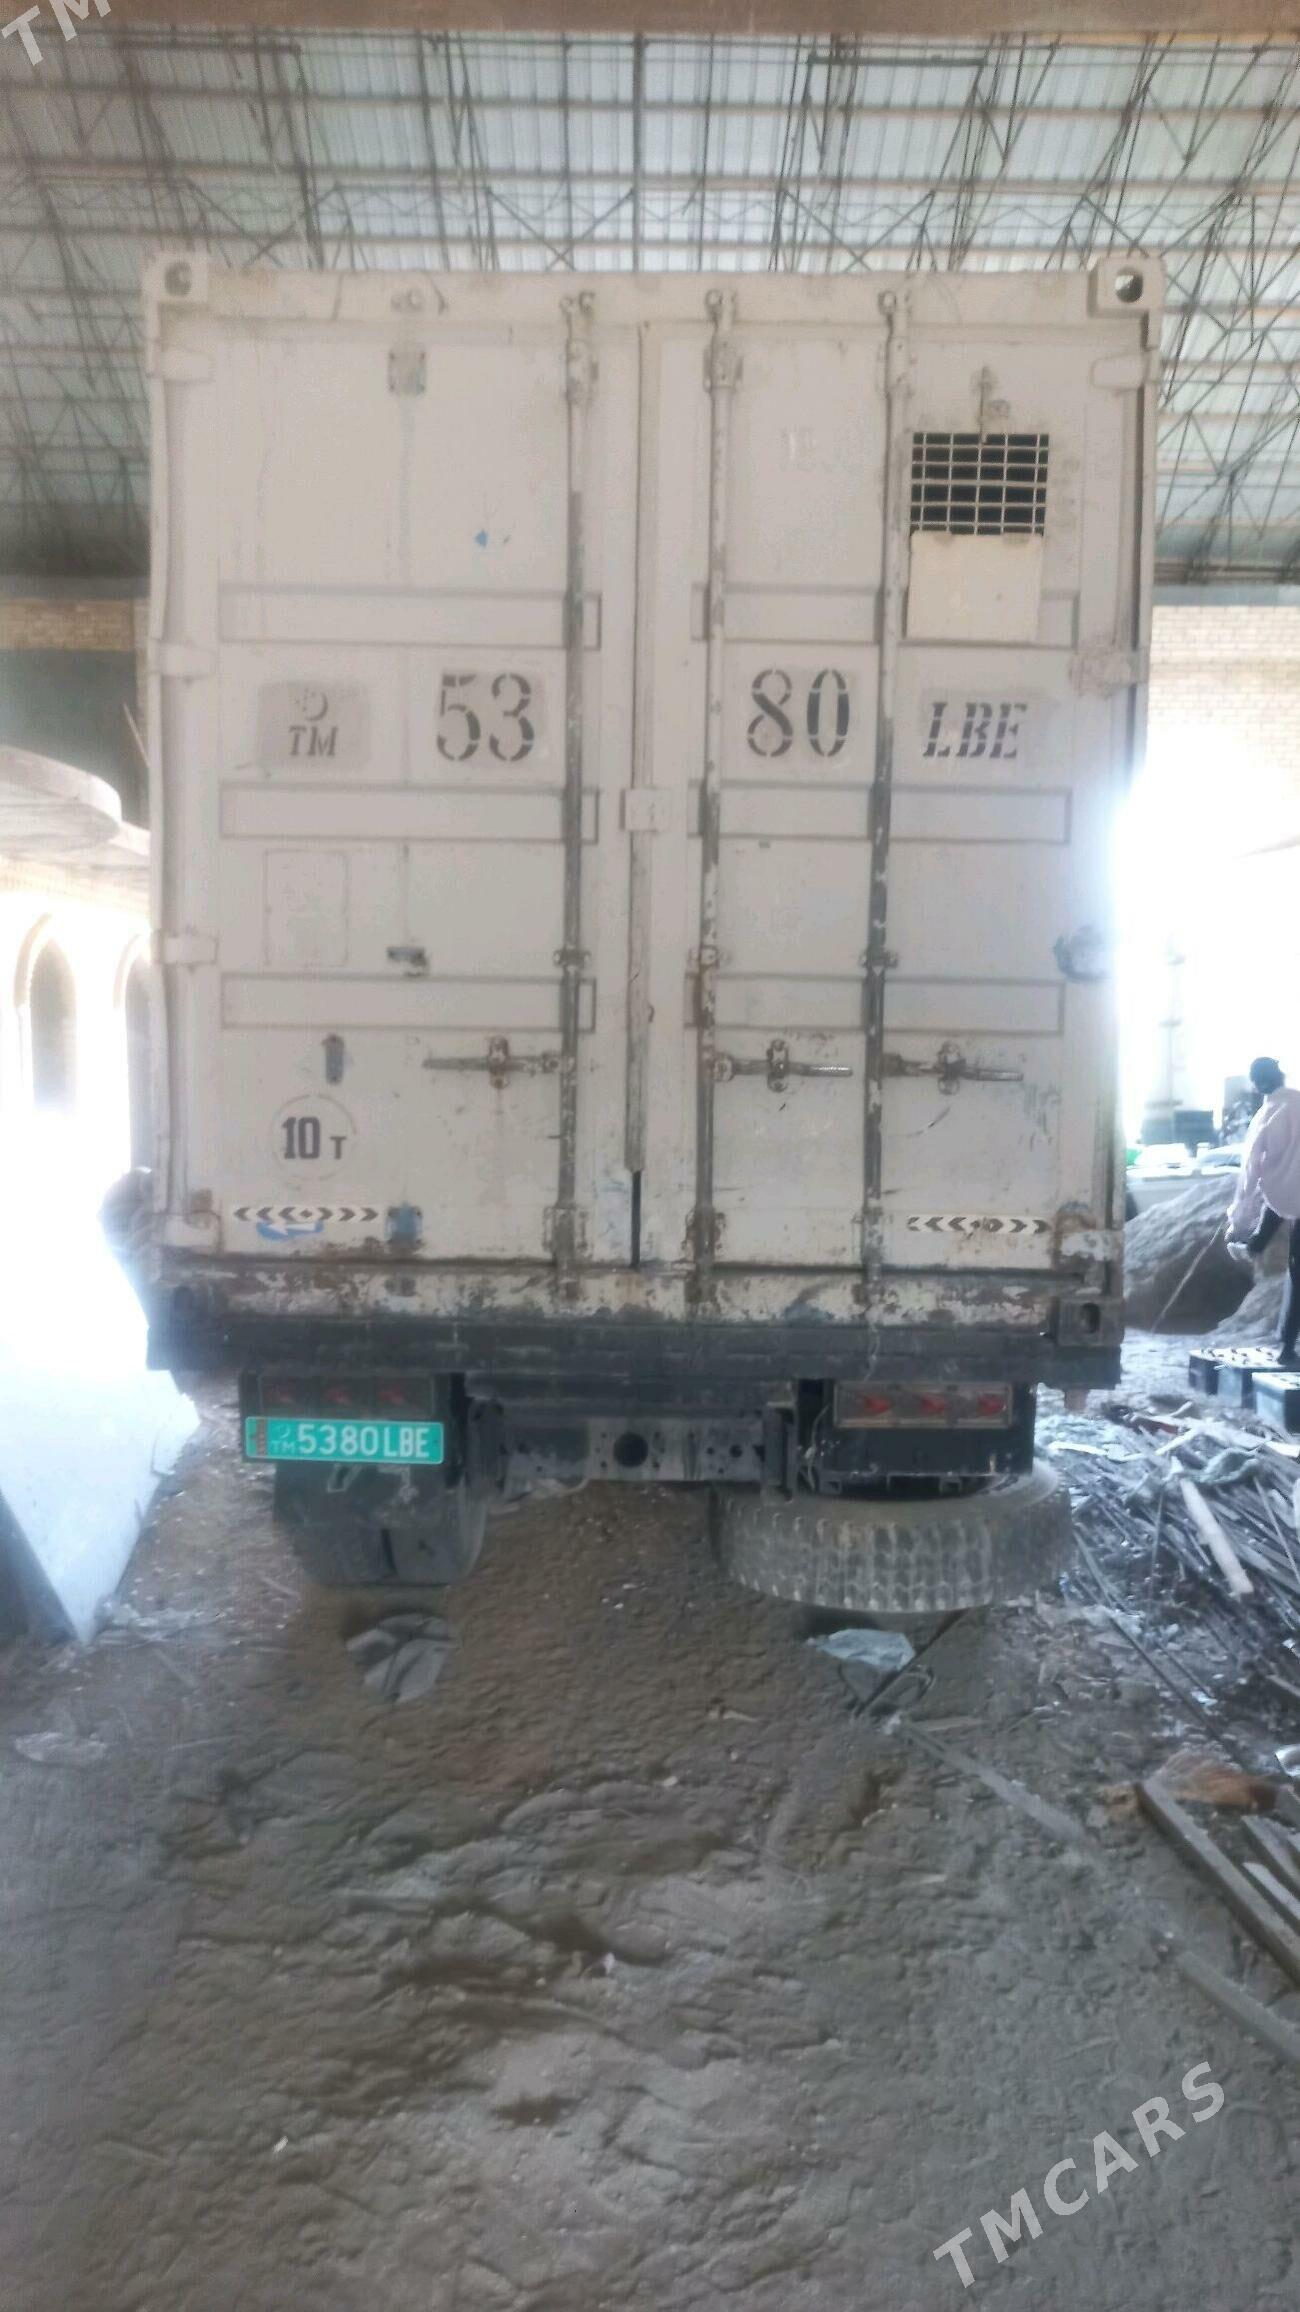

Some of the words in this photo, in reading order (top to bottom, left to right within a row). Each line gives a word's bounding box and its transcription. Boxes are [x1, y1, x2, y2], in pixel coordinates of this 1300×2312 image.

[289, 725, 338, 758] TM
[436, 673, 536, 762] 53
[747, 669, 850, 757] 80
[922, 702, 1027, 759] LBE
[282, 1117, 320, 1160] 10
[329, 1136, 347, 1160] T
